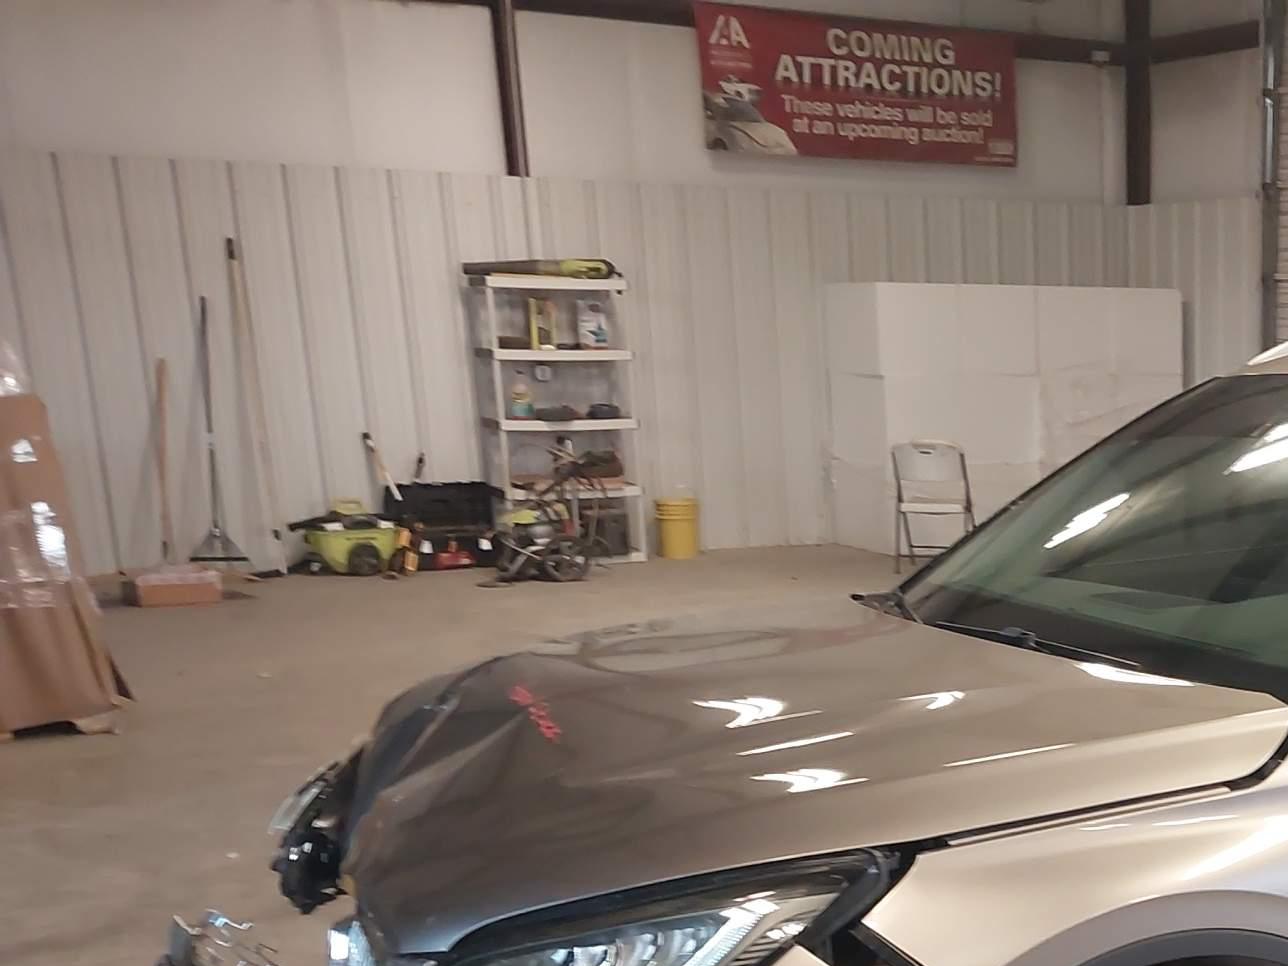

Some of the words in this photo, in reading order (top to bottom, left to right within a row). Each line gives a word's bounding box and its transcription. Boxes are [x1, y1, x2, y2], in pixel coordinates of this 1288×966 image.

[826, 28, 955, 65] COMING
[775, 54, 1001, 97] ATTRACTIONS!
[780, 94, 833, 117] These
[835, 100, 904, 122] vehicles
[905, 104, 934, 123] will
[936, 107, 958, 125] be
[960, 109, 993, 127] sold
[792, 116, 810, 134] at
[811, 119, 835, 135] an
[836, 121, 920, 145] upcoming
